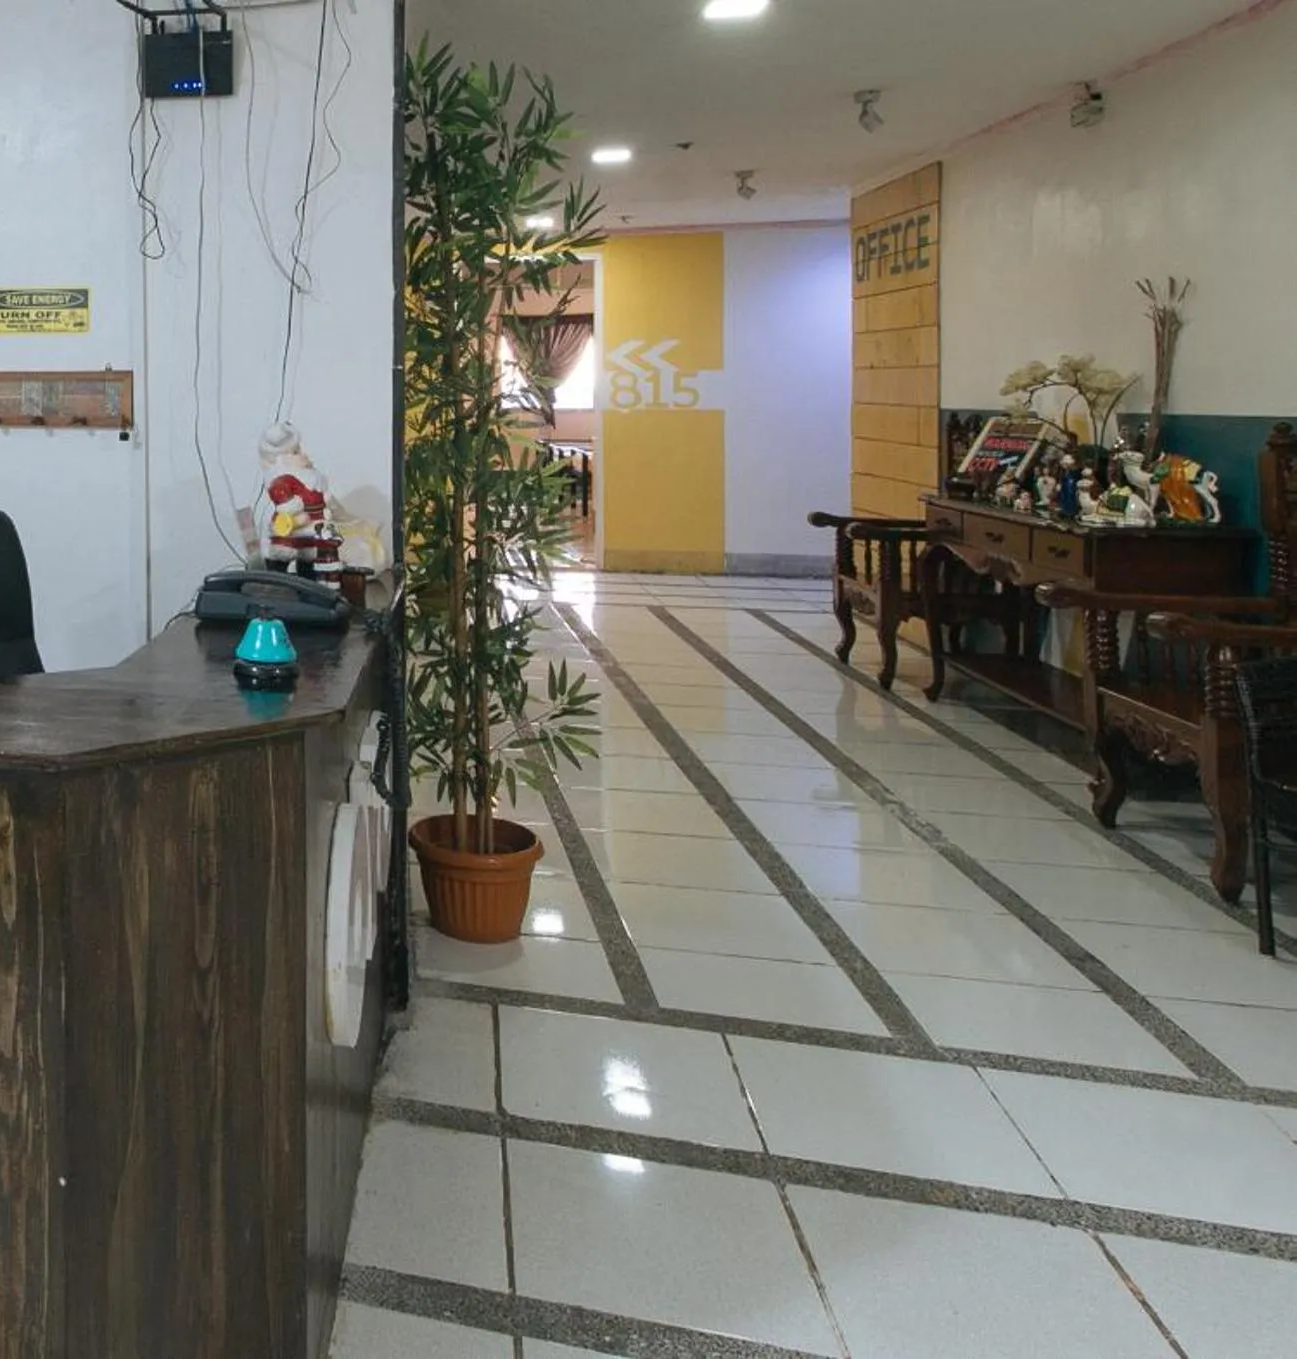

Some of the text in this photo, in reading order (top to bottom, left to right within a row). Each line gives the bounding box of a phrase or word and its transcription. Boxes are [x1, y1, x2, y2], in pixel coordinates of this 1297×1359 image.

[856, 214, 930, 282] OFFICE
[5, 292, 71, 306] SAVE ENERGY
[35, 310, 61, 319] OFF
[610, 370, 701, 409] 815
